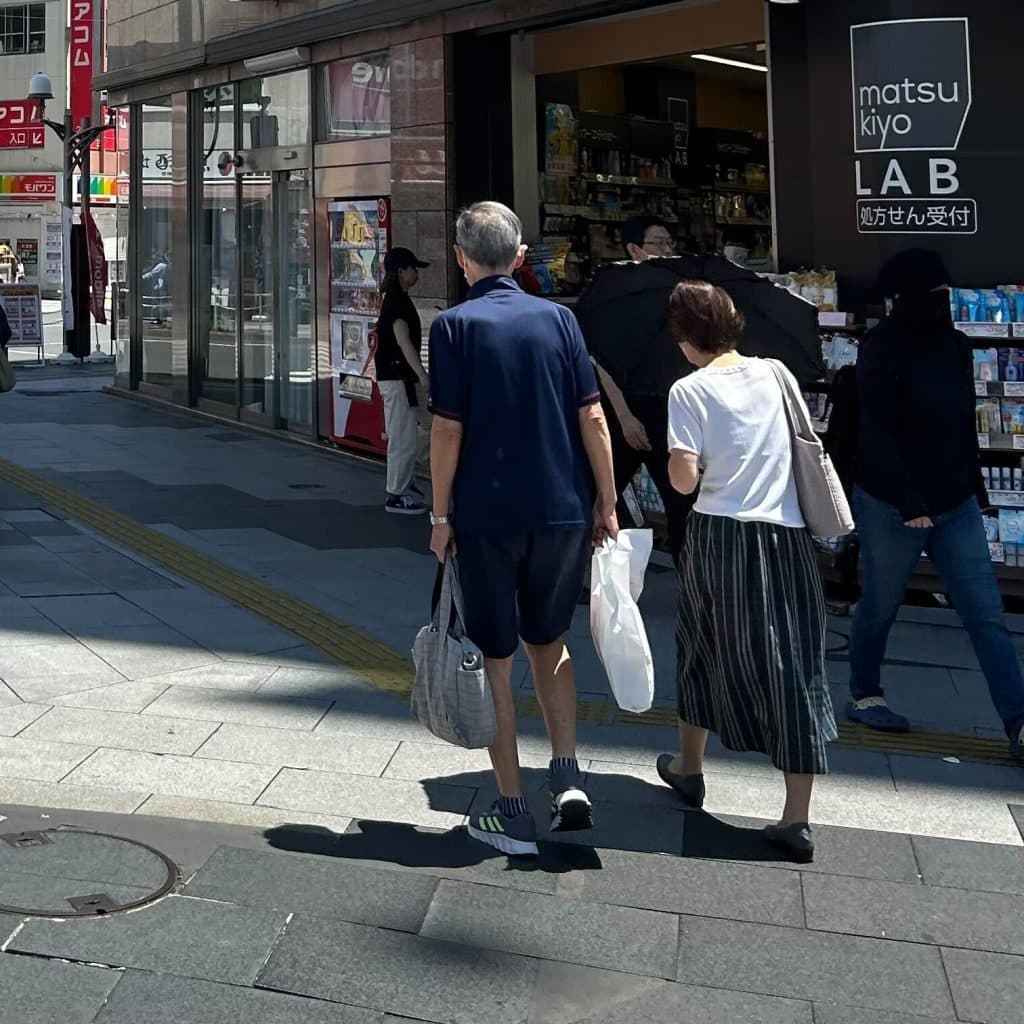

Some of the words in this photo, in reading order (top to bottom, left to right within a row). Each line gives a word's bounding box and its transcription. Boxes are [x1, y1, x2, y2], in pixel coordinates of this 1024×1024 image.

[74, 2, 90, 67] アコム
[860, 78, 958, 106] matsu
[9, 132, 27, 145] 入口
[860, 109, 912, 150] kiyo
[855, 157, 960, 196] LAB
[860, 205, 970, 227] 処方せん受付
